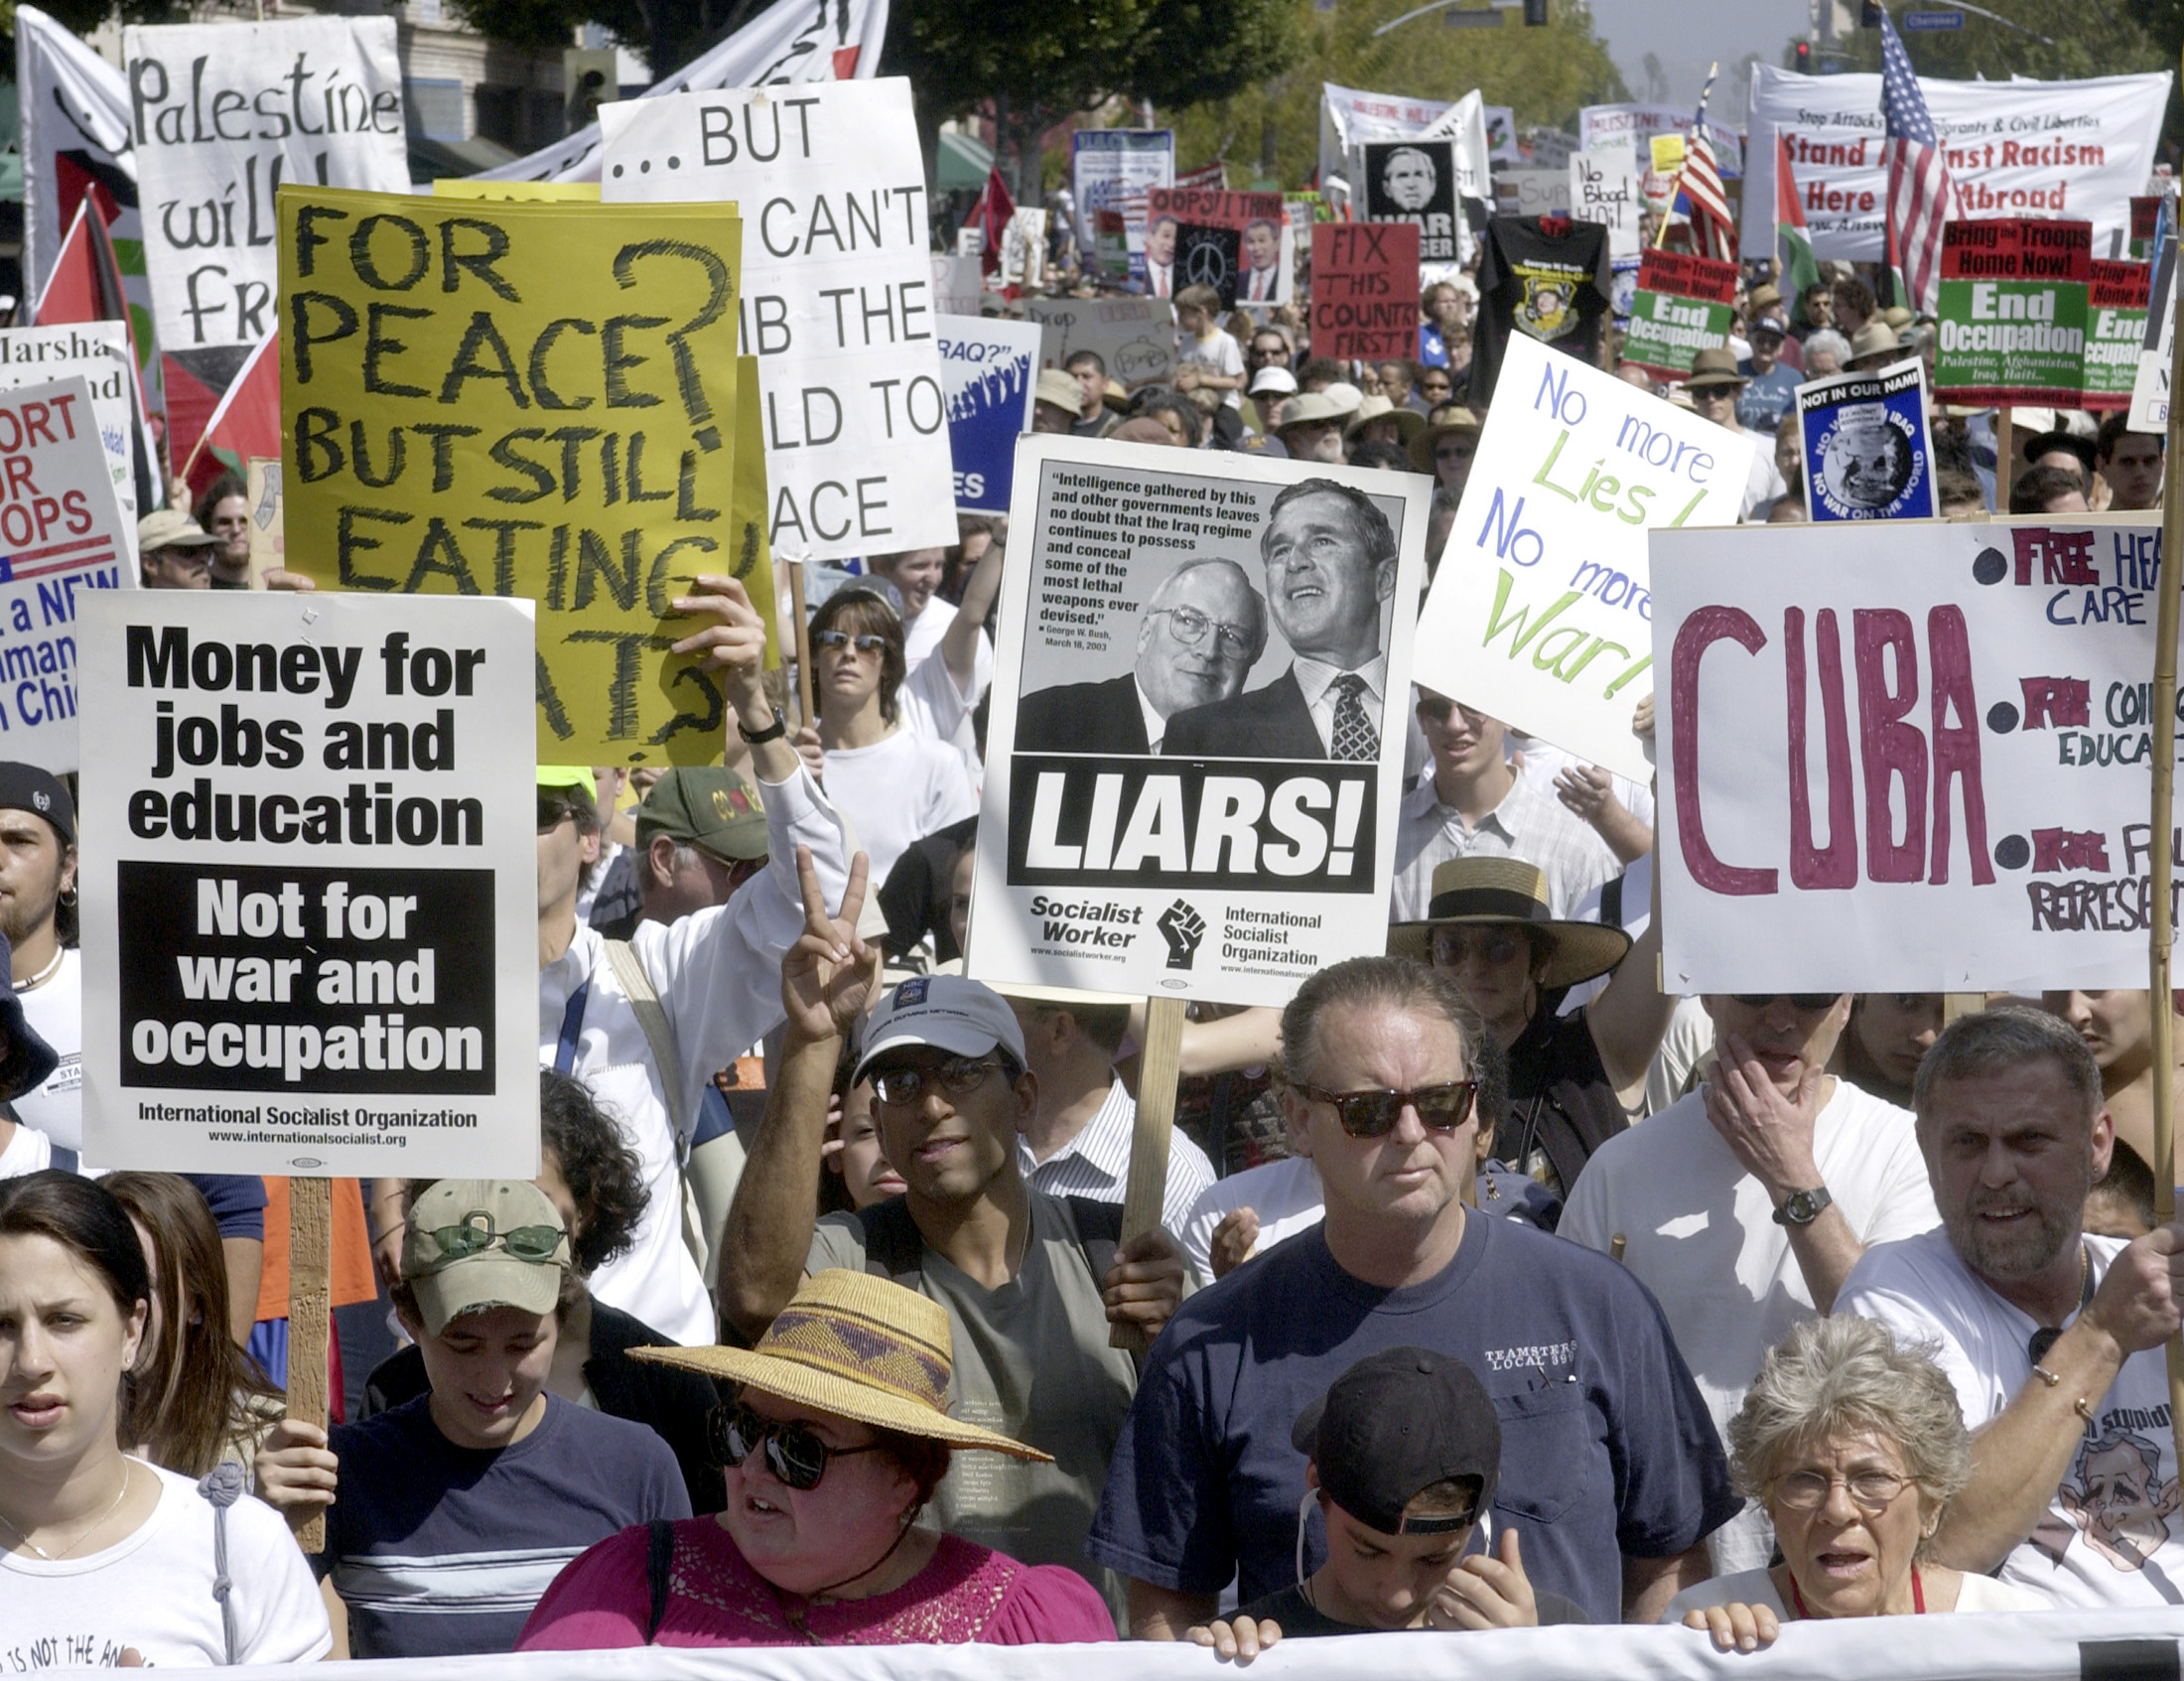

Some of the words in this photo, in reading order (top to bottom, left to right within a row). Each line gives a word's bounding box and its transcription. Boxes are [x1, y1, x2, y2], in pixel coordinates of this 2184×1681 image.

[130, 52, 400, 146] Palestine
[700, 98, 821, 168] BUT
[2044, 114, 2101, 130] Liberties
[1784, 134, 1866, 166] Stand
[2001, 136, 2105, 167] Racism
[1579, 160, 1602, 183] No
[1808, 182, 1875, 211] Here
[1958, 181, 2067, 211] Abroad
[759, 185, 925, 258] CAN'T
[1944, 221, 1997, 248] Bring
[2020, 221, 2090, 250] Troops
[296, 205, 522, 304] FOR
[1330, 225, 1388, 265] FIX
[1959, 250, 2017, 274] Home
[2022, 251, 2073, 276] Now!
[1317, 271, 1390, 296] THIS
[819, 281, 931, 350] THE
[1652, 294, 1709, 329] End
[1972, 283, 2055, 320] End
[1629, 315, 1724, 350] Occupation
[1940, 319, 2084, 354] Occupation
[1802, 392, 1828, 409] NOT
[1832, 386, 1846, 401] IN
[1850, 383, 1881, 396] OUR
[1884, 370, 1920, 394] NAME
[870, 375, 945, 440] TO
[1533, 360, 1587, 427] No
[1615, 412, 1714, 484] more
[1889, 410, 1915, 438] IRAQ
[295, 407, 484, 494] BUT
[482, 425, 721, 522] STILL
[1145, 483, 1207, 500] gathered
[1210, 489, 1227, 504] by
[1230, 490, 1257, 505] this
[1813, 472, 1827, 495] NO
[1823, 494, 1849, 519] WAR
[1851, 507, 1874, 519] ON
[1900, 450, 1924, 500] WORLD
[1051, 490, 1078, 503] and
[1081, 493, 1119, 508] other
[1122, 498, 1213, 518] governments
[1216, 505, 1261, 523] leaves
[1048, 524, 1118, 542] continues
[1121, 530, 1136, 544] to
[1138, 534, 1196, 550] possess
[1050, 508, 1068, 519] no
[1071, 508, 1111, 524] doubt
[1114, 512, 1143, 527] that
[1146, 515, 1169, 530] the
[1171, 518, 1200, 536] Iraq
[1202, 523, 1253, 539] regime
[1476, 486, 1544, 568] No
[338, 505, 719, 620] EATING
[1046, 541, 1073, 555] and
[1076, 545, 1132, 560] conceal
[1044, 558, 1083, 573] some
[1086, 561, 1102, 574] of
[1105, 562, 1128, 577] the
[1043, 575, 1079, 590] most
[1082, 577, 1123, 594] lethal
[1041, 593, 1105, 609] weapons
[1108, 599, 1140, 613] ever
[2046, 586, 2146, 626] CARE
[1045, 637, 1072, 648] March
[1046, 625, 1075, 637] George
[126, 625, 363, 709] Money
[380, 631, 486, 697] for
[151, 701, 305, 777] jobs
[323, 708, 456, 771] and
[1671, 603, 1997, 897] CUBA
[127, 778, 483, 846] education
[1024, 771, 1366, 876] LIARS!
[197, 877, 305, 939] Not
[322, 881, 417, 939] for
[1030, 896, 1144, 924] Socialist
[1225, 906, 1322, 929] International
[1042, 920, 1137, 948] Worker
[1223, 924, 1289, 944] Socialist
[1030, 946, 1126, 963] www.socialistworker.org
[1222, 943, 1318, 966] Organization
[177, 955, 302, 1004] war
[317, 948, 436, 1005] and
[131, 1014, 483, 1082] occupation
[138, 1102, 261, 1126] International
[266, 1105, 350, 1127] Socialist
[354, 1108, 478, 1131] Organization
[208, 1130, 407, 1148] www.internationalsocialist.org
[1484, 1339, 1578, 1362] TEAMSTERS
[1492, 1355, 1546, 1371] LOCAL
[7, 1646, 27, 1673] IS
[30, 1636, 59, 1670] NOT
[66, 1634, 94, 1665] THE
